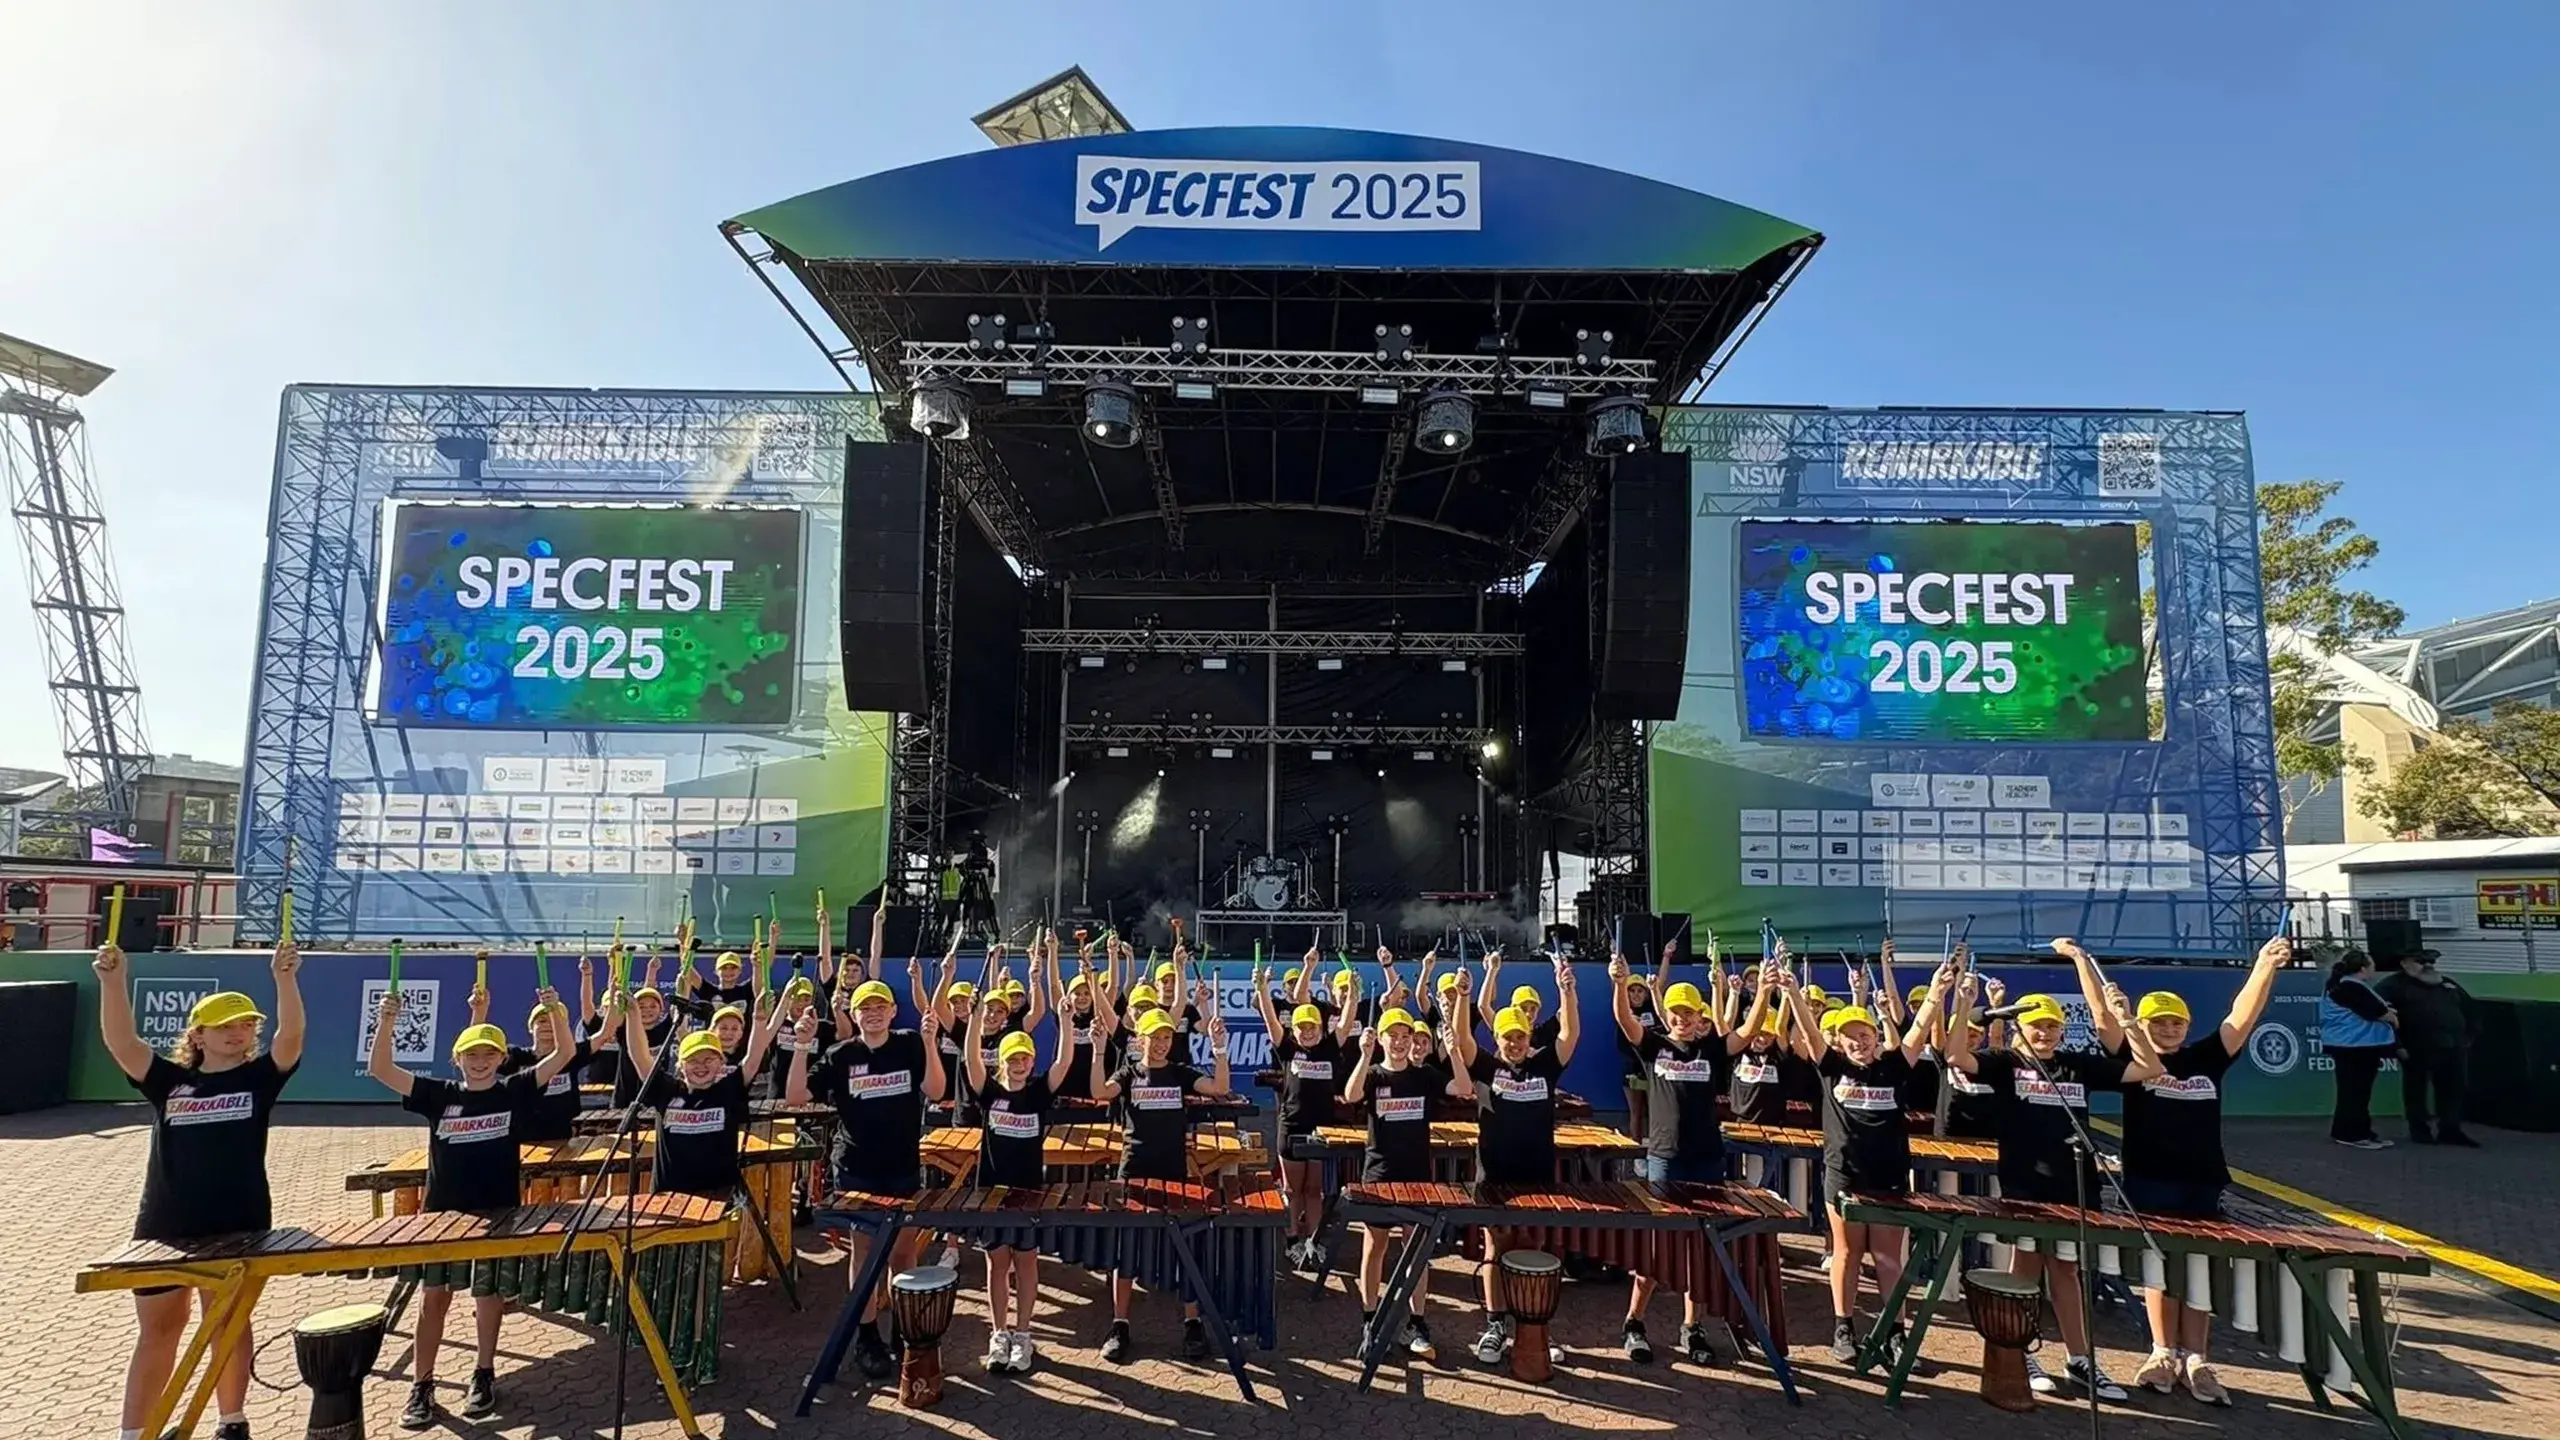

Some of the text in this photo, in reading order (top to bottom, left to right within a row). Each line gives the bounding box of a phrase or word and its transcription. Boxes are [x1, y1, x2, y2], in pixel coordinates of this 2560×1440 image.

[1086, 167, 1468, 220] SPECFEST 2025
[1730, 466, 1787, 486] NSW
[1842, 441, 2048, 480] REMARKABLE
[456, 557, 735, 612] SPECFEST
[1804, 571, 2075, 625] SPECFEST
[512, 626, 665, 679] 2025
[1870, 640, 2018, 693] 2025
